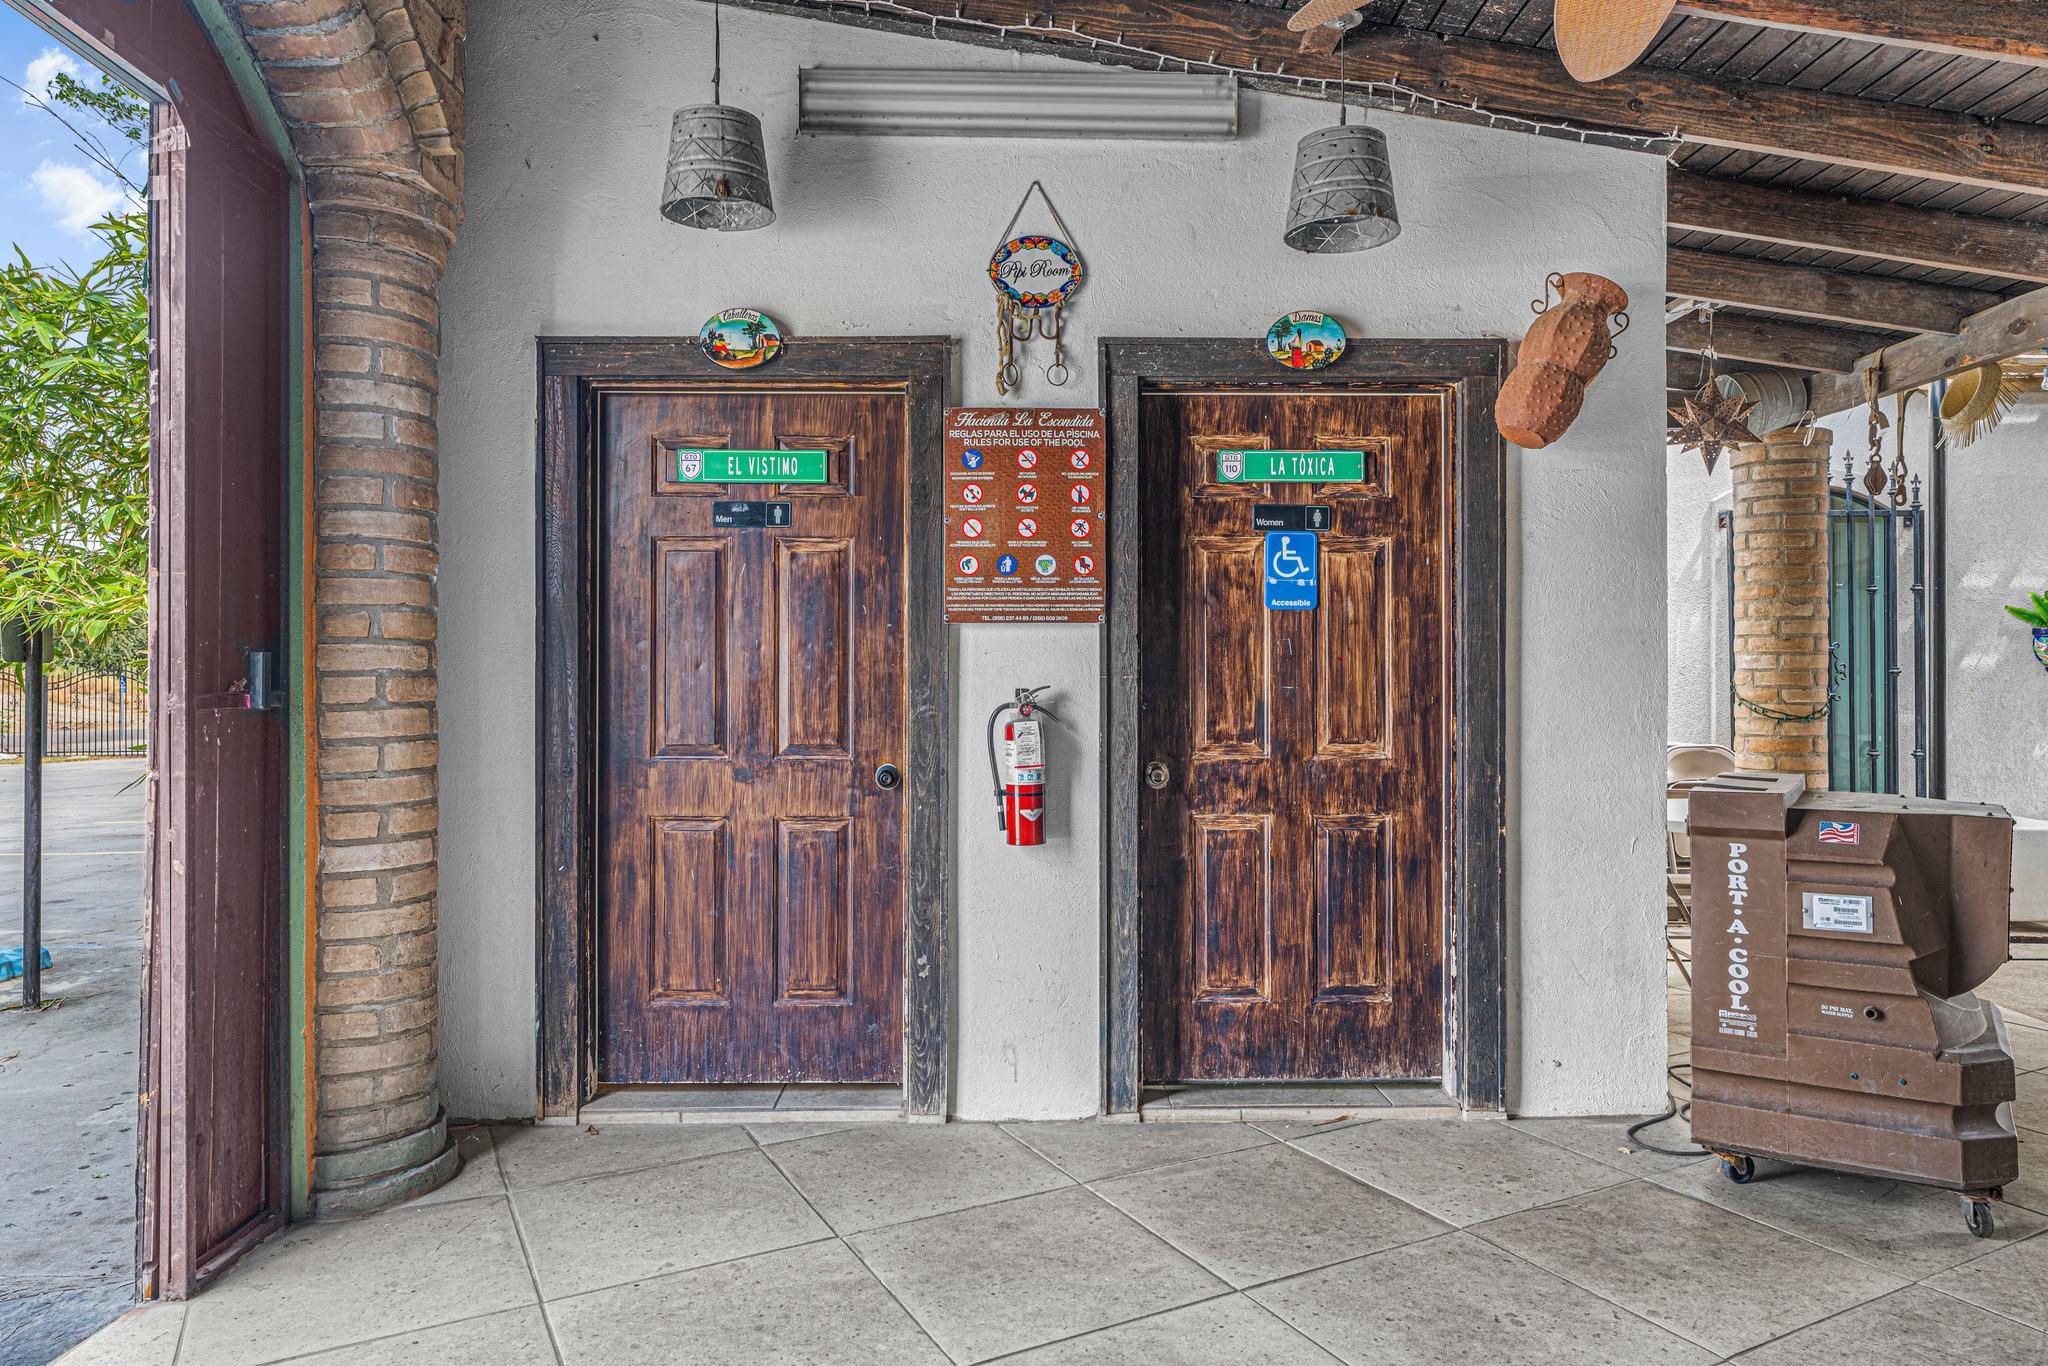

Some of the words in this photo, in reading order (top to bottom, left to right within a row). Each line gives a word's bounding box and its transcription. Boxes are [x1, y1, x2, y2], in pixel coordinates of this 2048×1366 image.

[1000, 260, 1027, 284] Pipi
[1030, 259, 1070, 278] Room
[955, 411, 1009, 427] Hacienda
[1012, 412, 1034, 427] La
[1038, 411, 1095, 427] Escondida
[949, 430, 983, 438] REGLAS
[984, 430, 1008, 438] PARA
[1010, 430, 1020, 438] EL
[1022, 430, 1040, 438] USO
[1041, 430, 1053, 438] DE
[1054, 430, 1065, 438] LA
[963, 438, 992, 447] RULES
[993, 438, 1011, 447] FOR
[1012, 438, 1030, 447] USE
[1030, 438, 1042, 447] OF
[1043, 438, 1060, 447] THE
[1061, 438, 1086, 447] POOL
[685, 463, 697, 473] 67
[727, 456, 742, 475] EL
[749, 456, 798, 476] VISTIMO
[1225, 464, 1238, 473] 110
[1270, 457, 1286, 476] LA
[1292, 453, 1335, 476] TÓXICA
[715, 515, 733, 523] Men
[1256, 518, 1284, 527] Women
[1271, 598, 1311, 607] Accessible
